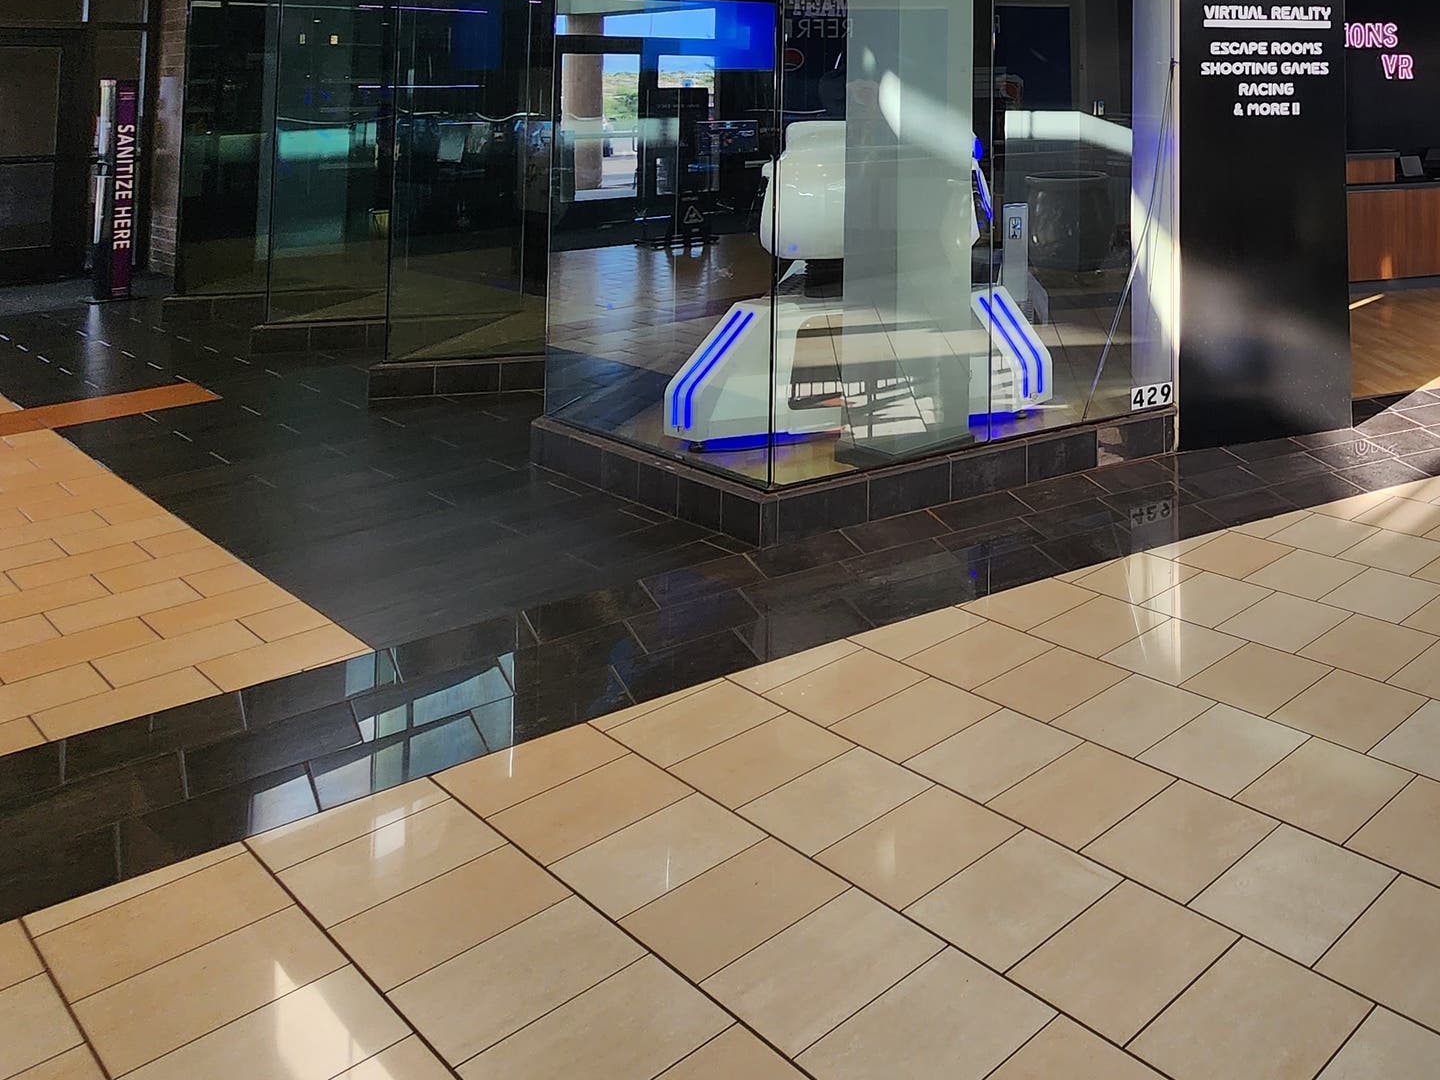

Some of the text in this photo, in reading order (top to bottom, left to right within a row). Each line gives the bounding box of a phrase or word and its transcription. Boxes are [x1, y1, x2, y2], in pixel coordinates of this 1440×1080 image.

[1203, 5, 1331, 20] VIRTUAL REALITY
[1210, 42, 1323, 55] ESCAPE ROOMS
[1201, 62, 1329, 75] SHOOTING GAMES
[1381, 54, 1413, 79] VR
[1238, 82, 1294, 96] RACING
[1233, 102, 1244, 116] &
[1247, 102, 1290, 116] MORE
[113, 124, 135, 250] SANITIZE HERE
[1132, 384, 1171, 408] 429
